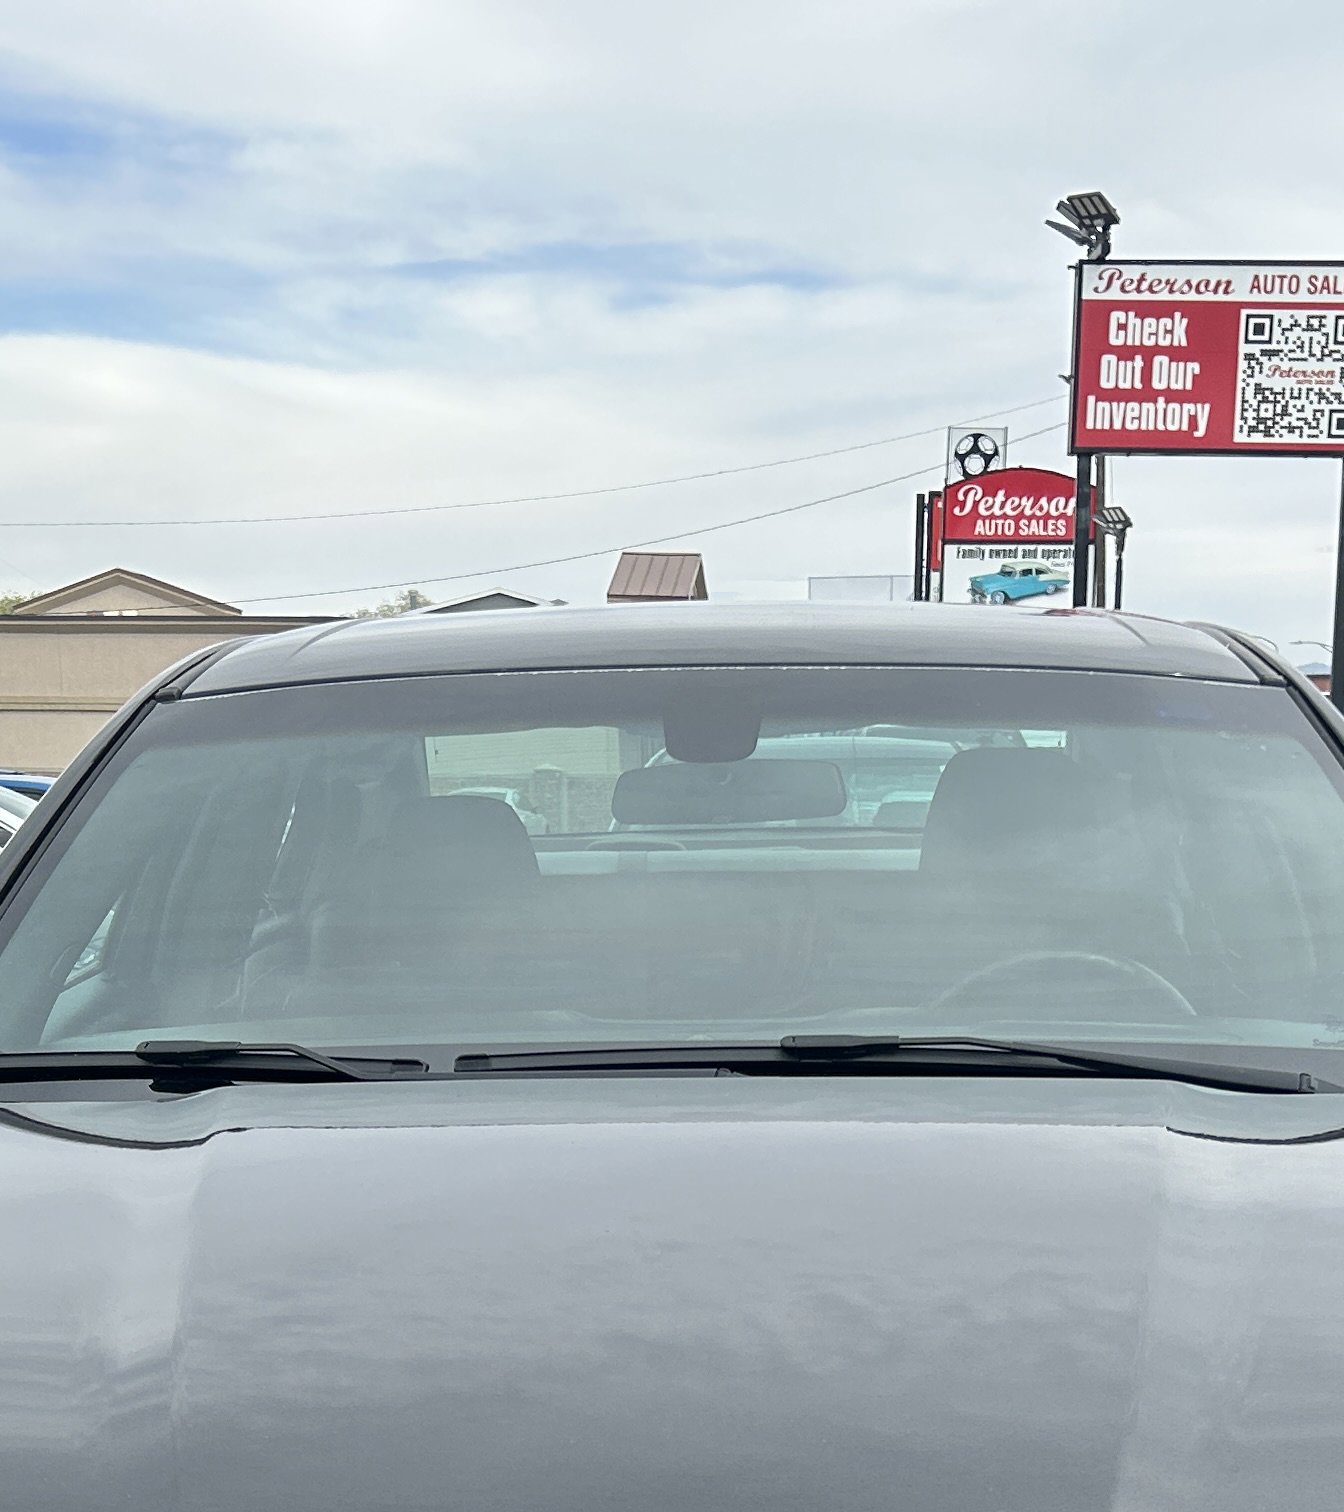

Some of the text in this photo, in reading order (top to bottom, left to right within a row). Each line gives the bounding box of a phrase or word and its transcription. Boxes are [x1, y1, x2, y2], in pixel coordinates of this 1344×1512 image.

[1093, 267, 1235, 295] Peterson
[1249, 275, 1300, 295] AUTO
[1108, 310, 1189, 347] Check
[1099, 353, 1201, 391] Out Our
[1265, 364, 1336, 379] Peterson
[1085, 395, 1211, 438] Inventory
[973, 518, 1067, 537] AUTO SALES
[956, 547, 985, 561] Family
[989, 547, 1018, 559] owned
[1022, 547, 1038, 559] and
